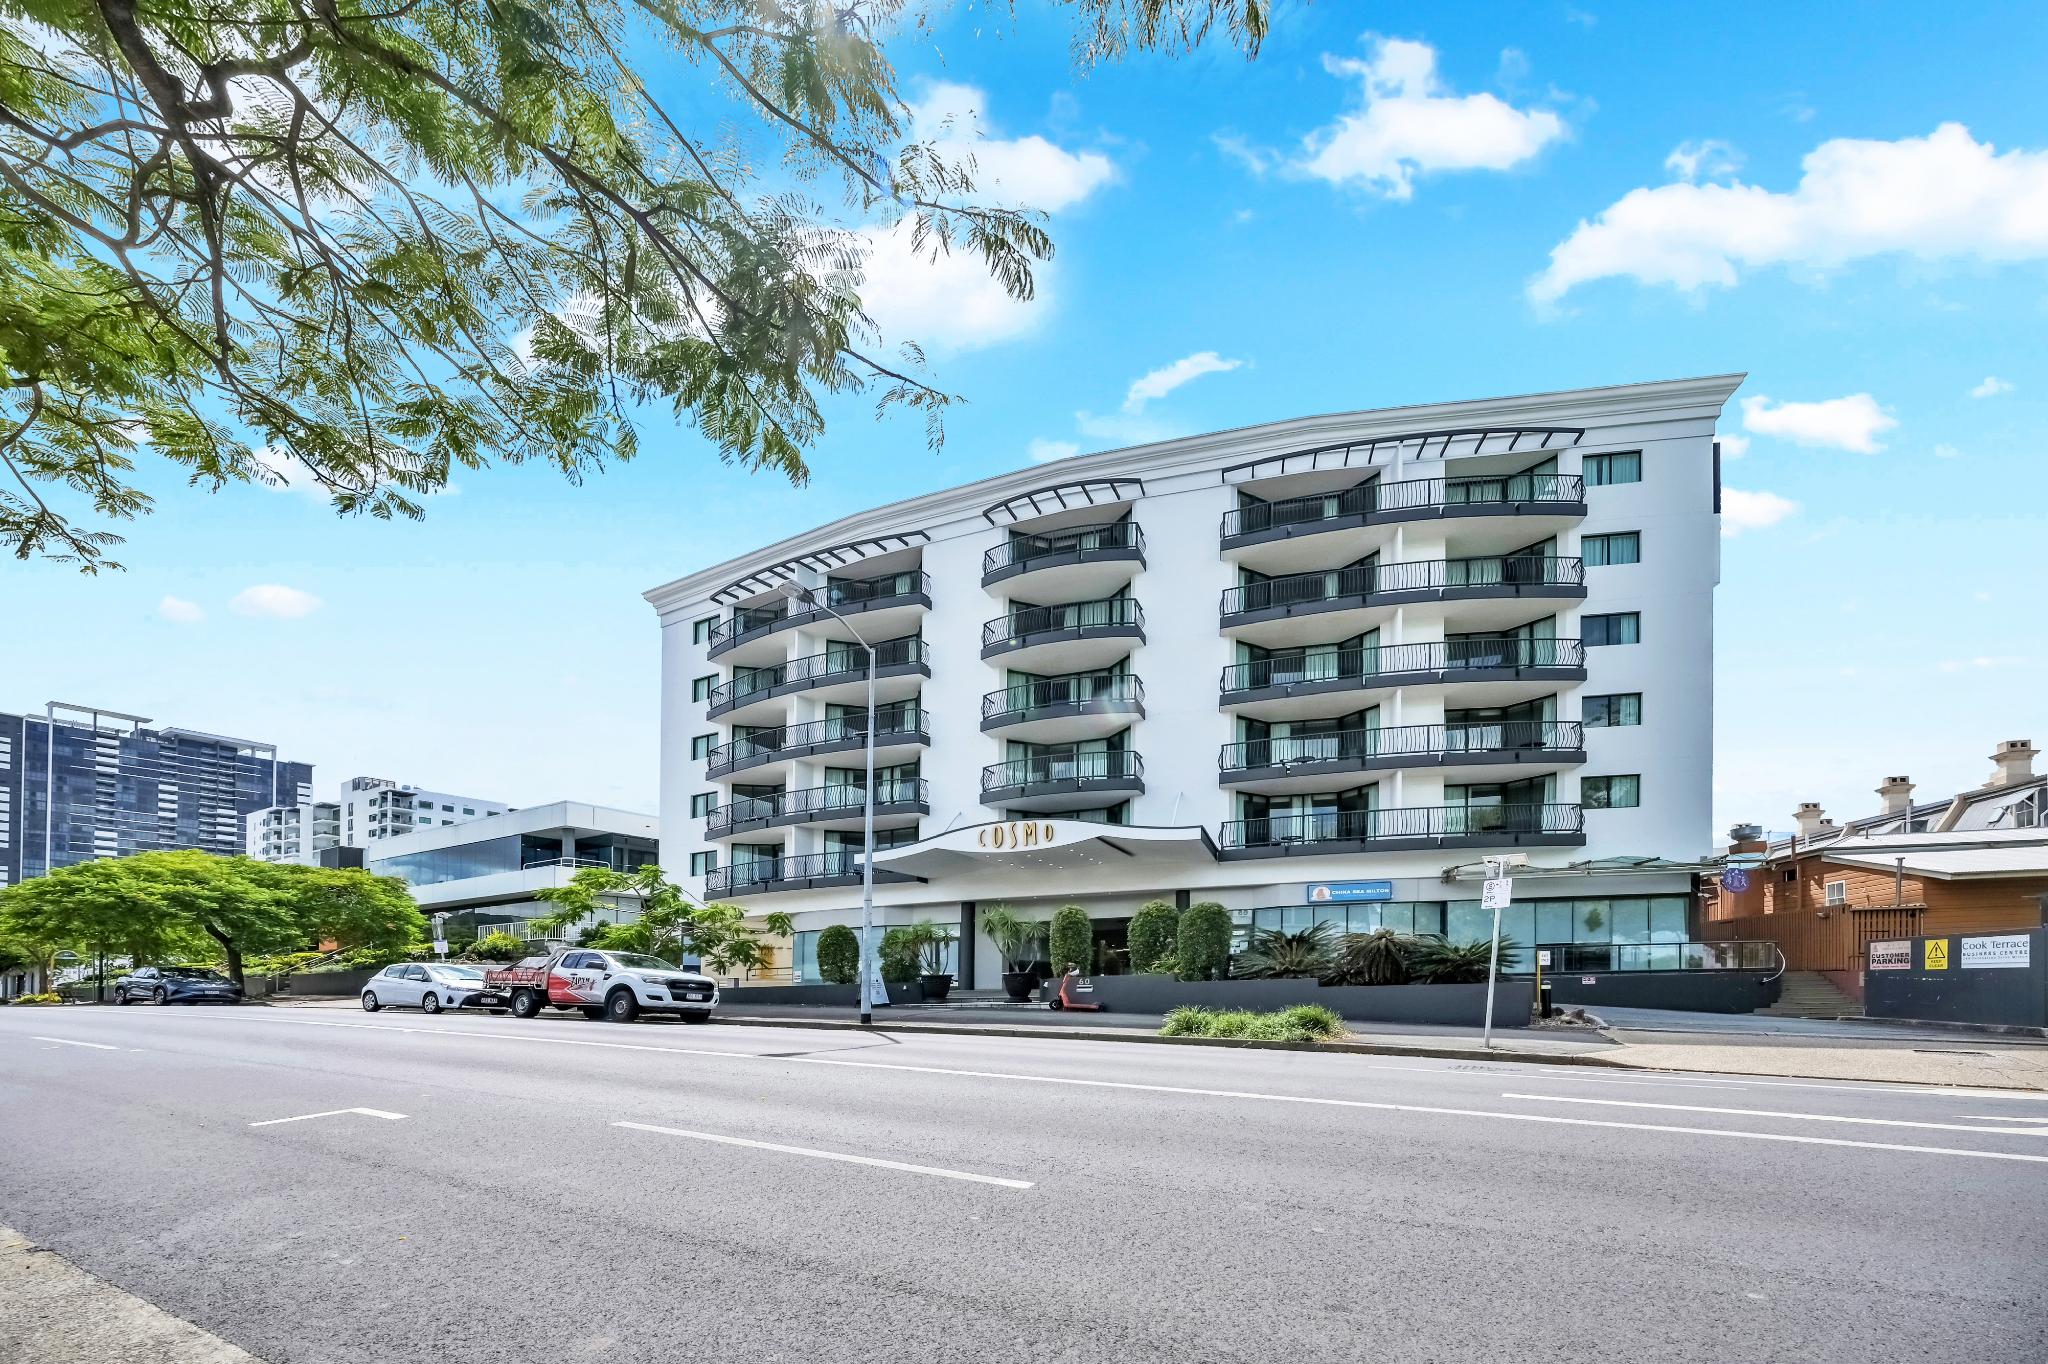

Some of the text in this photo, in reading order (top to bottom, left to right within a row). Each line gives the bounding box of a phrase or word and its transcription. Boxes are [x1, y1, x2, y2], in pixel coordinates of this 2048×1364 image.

[978, 821, 1054, 849] COSMO
[1483, 895, 1496, 903] 2P
[1962, 940, 2029, 950] Cook Terrace
[1871, 957, 1910, 965] PARKING
[1078, 977, 1090, 985] 60
